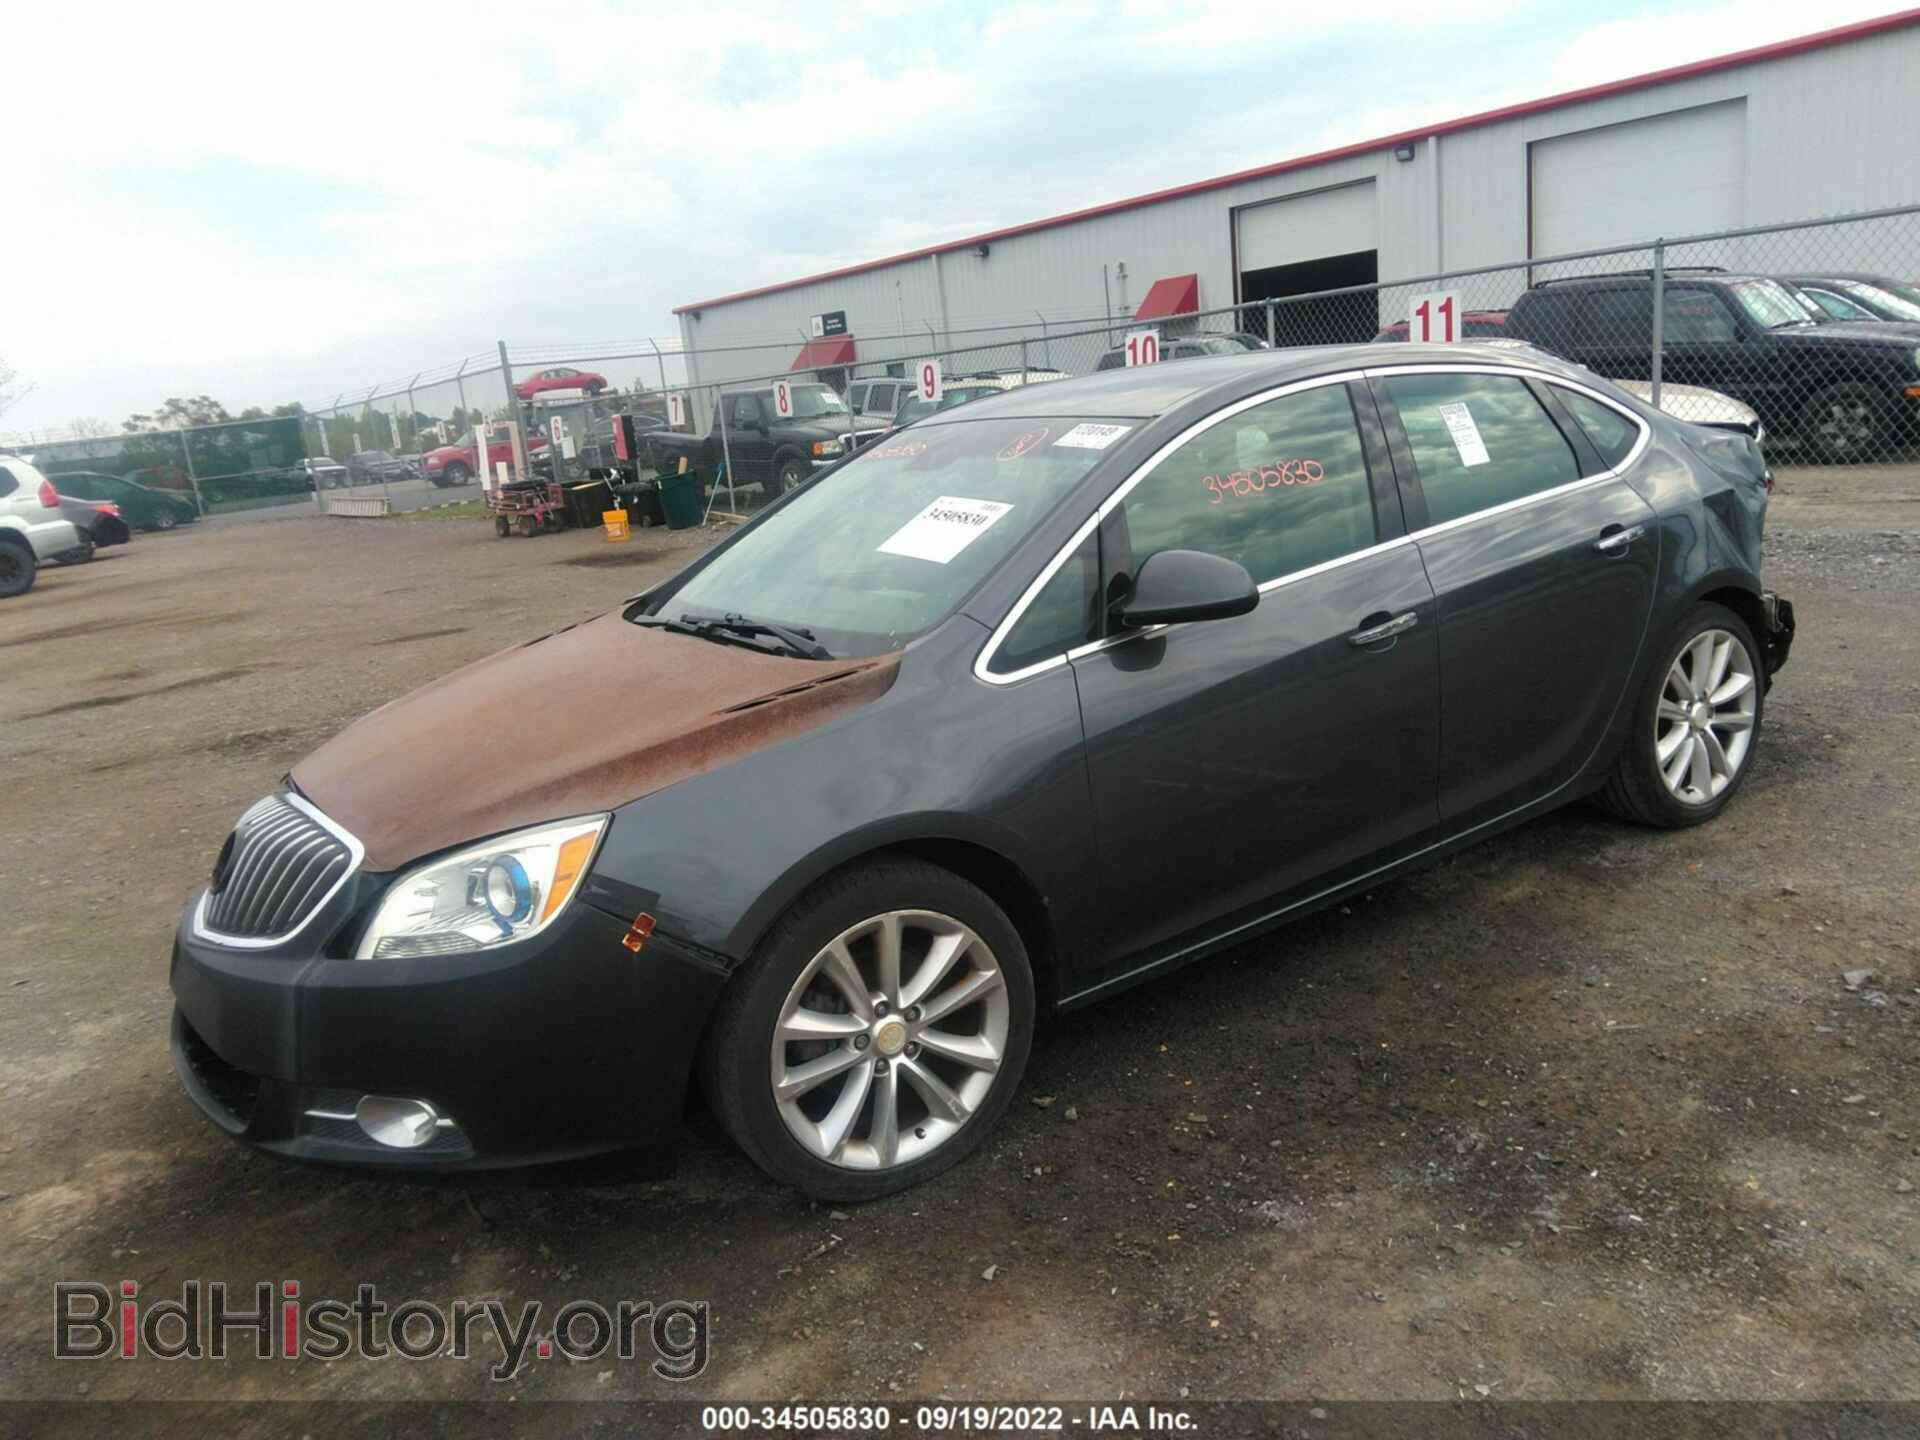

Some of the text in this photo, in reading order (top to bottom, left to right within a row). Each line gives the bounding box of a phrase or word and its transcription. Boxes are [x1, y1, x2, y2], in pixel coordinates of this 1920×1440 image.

[1416, 296, 1455, 344] 11
[1127, 335, 1158, 366] 10
[923, 364, 936, 399] 9
[669, 396, 681, 424] 7
[778, 384, 789, 413] 8
[1203, 457, 1324, 505] 34505830
